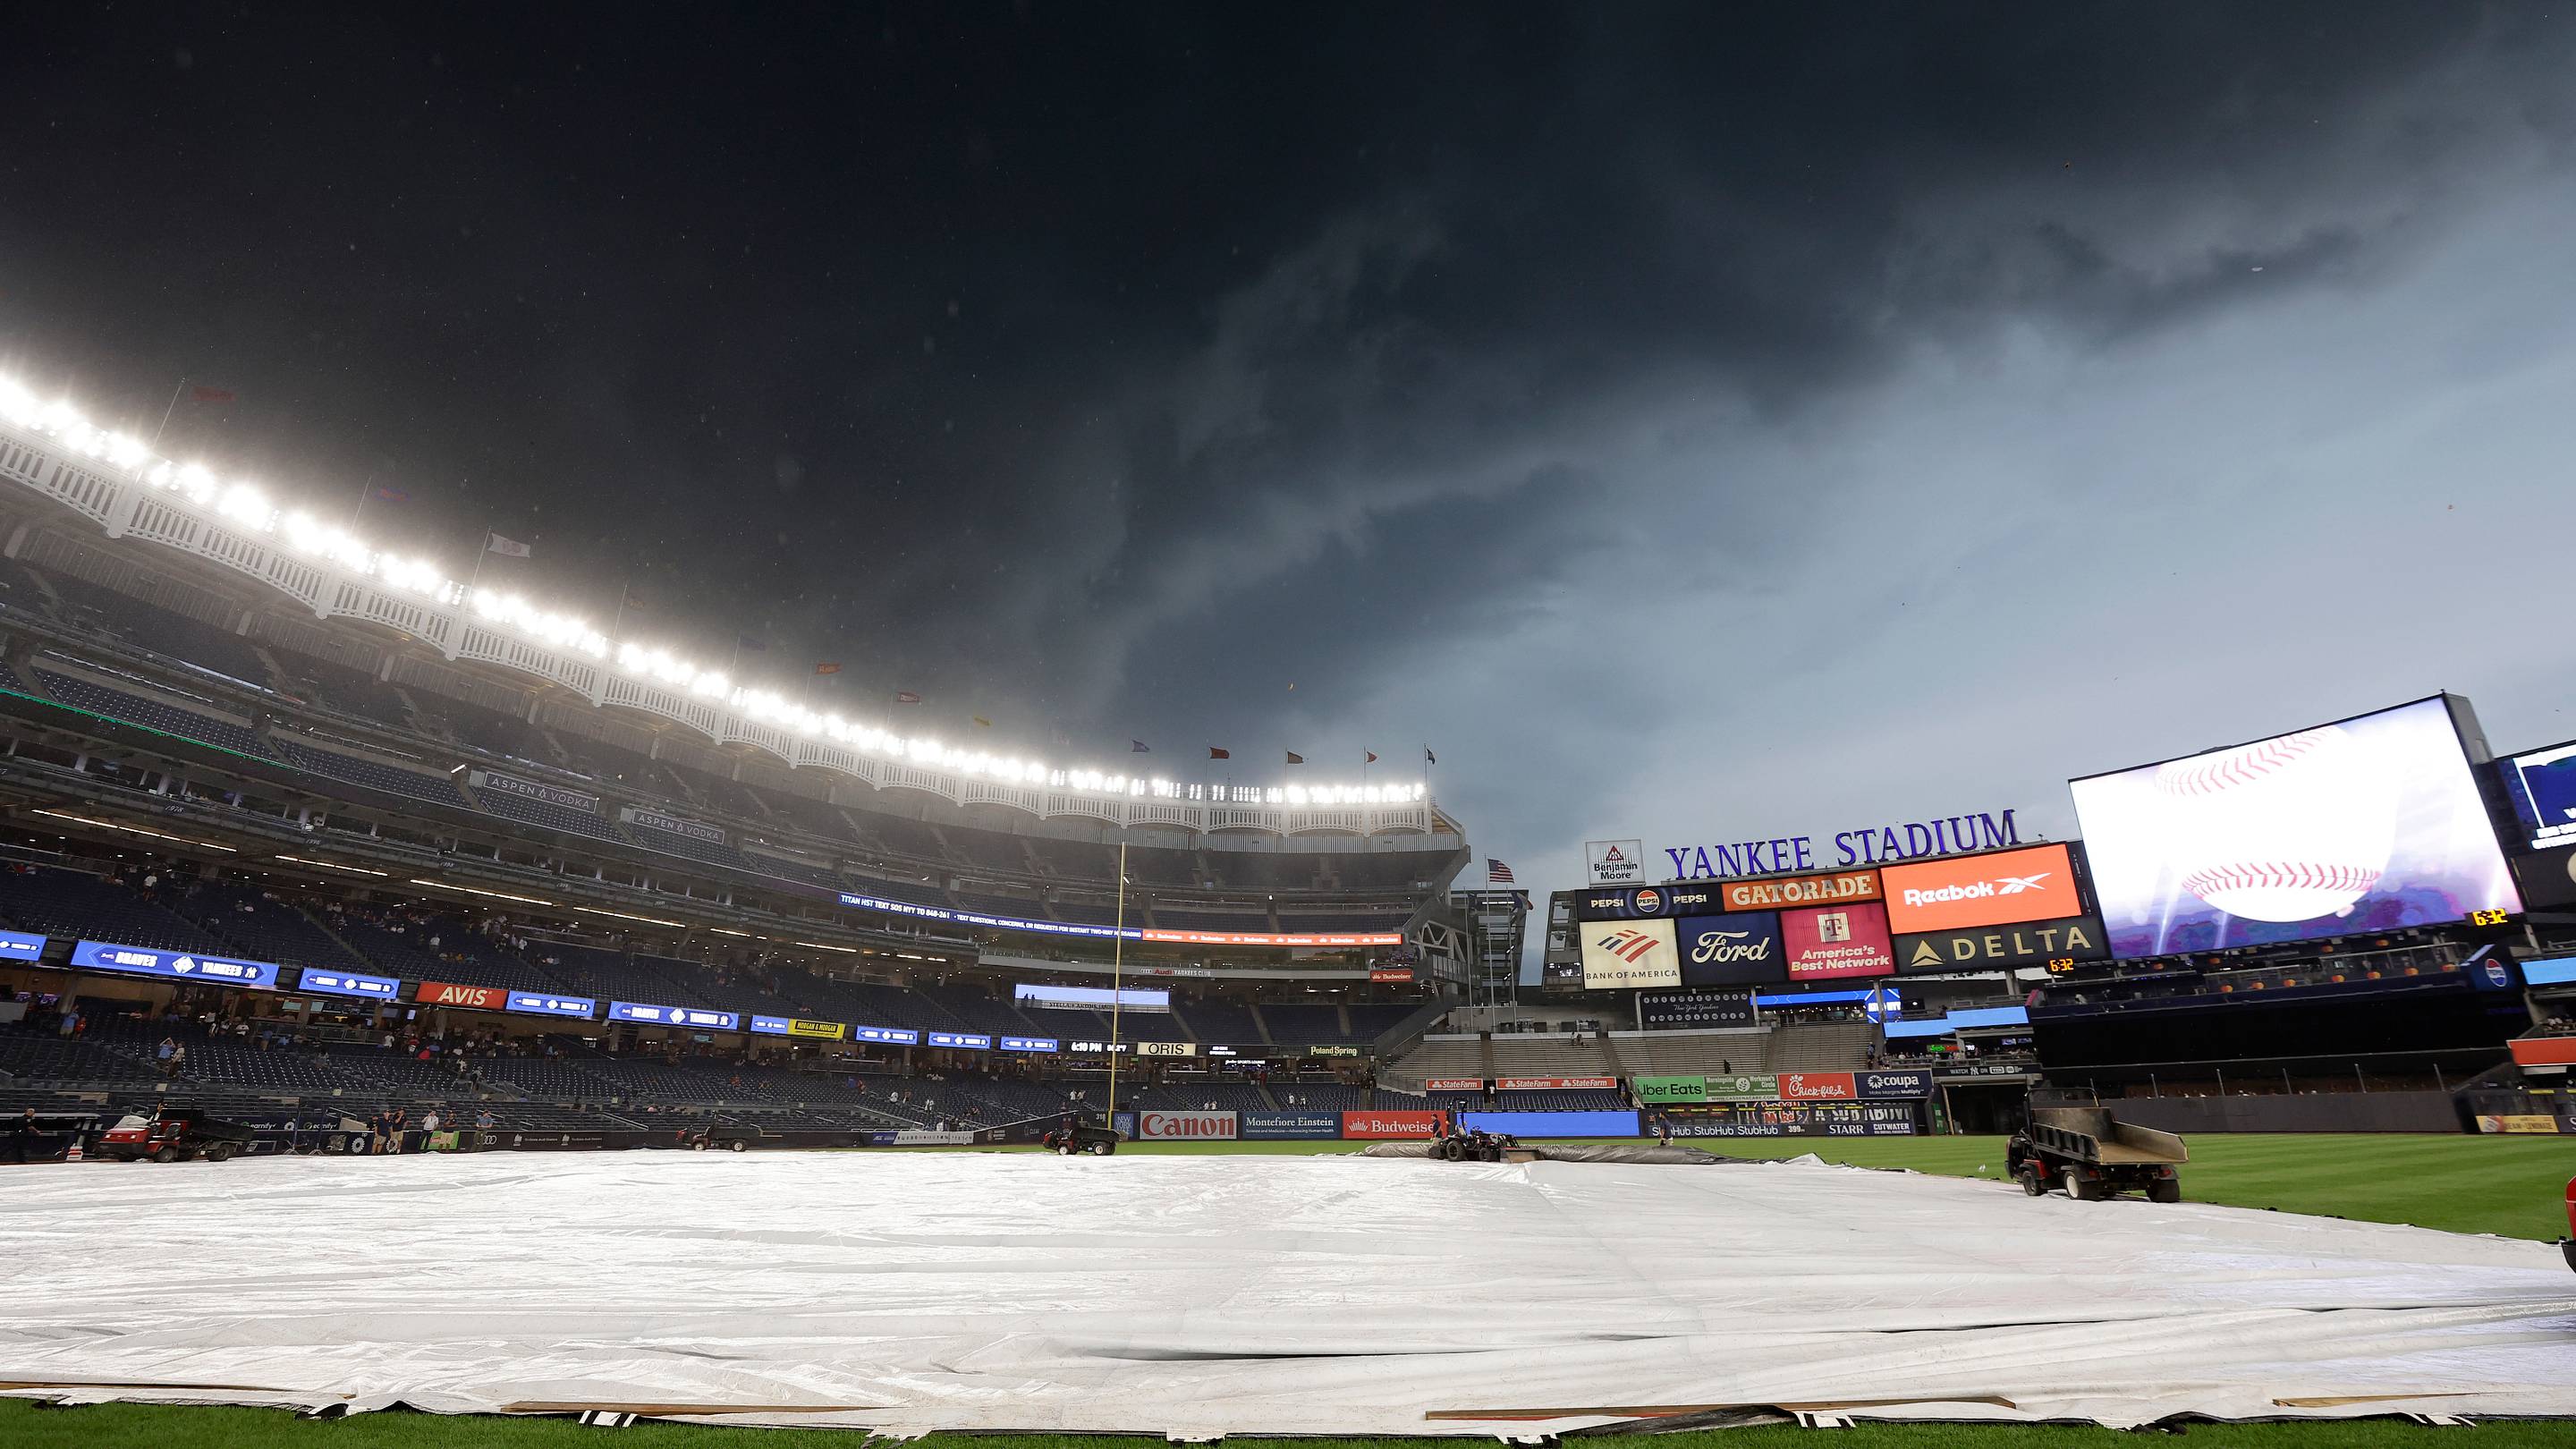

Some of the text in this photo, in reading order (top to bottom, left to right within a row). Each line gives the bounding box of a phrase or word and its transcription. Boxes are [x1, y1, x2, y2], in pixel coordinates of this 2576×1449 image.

[492, 777, 590, 809] ASPEN VODKA
[638, 814, 719, 840] ASPEN VODKA
[1665, 836, 1815, 881] YANKEE
[1835, 809, 2021, 867] STADIUM
[1594, 862, 1638, 872] Benjamin
[1600, 871, 1631, 880] Moore
[1732, 874, 1872, 905] GATORADE
[1903, 882, 1995, 907] Reebok
[841, 895, 860, 905] TITAN
[875, 901, 890, 910] TEXT
[890, 903, 902, 911] SOS
[917, 908, 926, 916] TO
[1590, 898, 1624, 908] PEPSI
[1638, 897, 1658, 905] PEPSI
[1673, 894, 1707, 905] PEPSI
[956, 914, 969, 922] TEXT
[2472, 908, 2508, 927] 6:32
[1691, 931, 1771, 964] Ford
[1952, 927, 2092, 962] DELTA
[1801, 945, 1876, 961] America's
[1791, 954, 1890, 971] Best Network
[2049, 958, 2074, 972] 6:32
[1586, 970, 1678, 980] BANK OF AMERICA
[436, 987, 488, 1006] AVIS
[796, 1021, 815, 1030] MORGAN
[818, 1024, 836, 1032] MORGAN
[1089, 1042, 1103, 1053] PM
[1148, 1044, 1184, 1055] ORIS
[1310, 1046, 1358, 1056] Poland Spring
[1789, 1080, 1846, 1097] Chick-fil-A
[1884, 1075, 1919, 1089] coupa
[1670, 1083, 1702, 1096] Eats
[1141, 1113, 1234, 1137] Canon
[1246, 1116, 1335, 1126] Montefiore Einstein
[1371, 1119, 1436, 1133] Budweise
[1873, 1123, 1910, 1131] CUTWATER
[1694, 1126, 1734, 1136] StubHub
[1737, 1125, 1779, 1135] StubHub
[1788, 1124, 1801, 1133] 399
[1829, 1124, 1865, 1134] STARR
